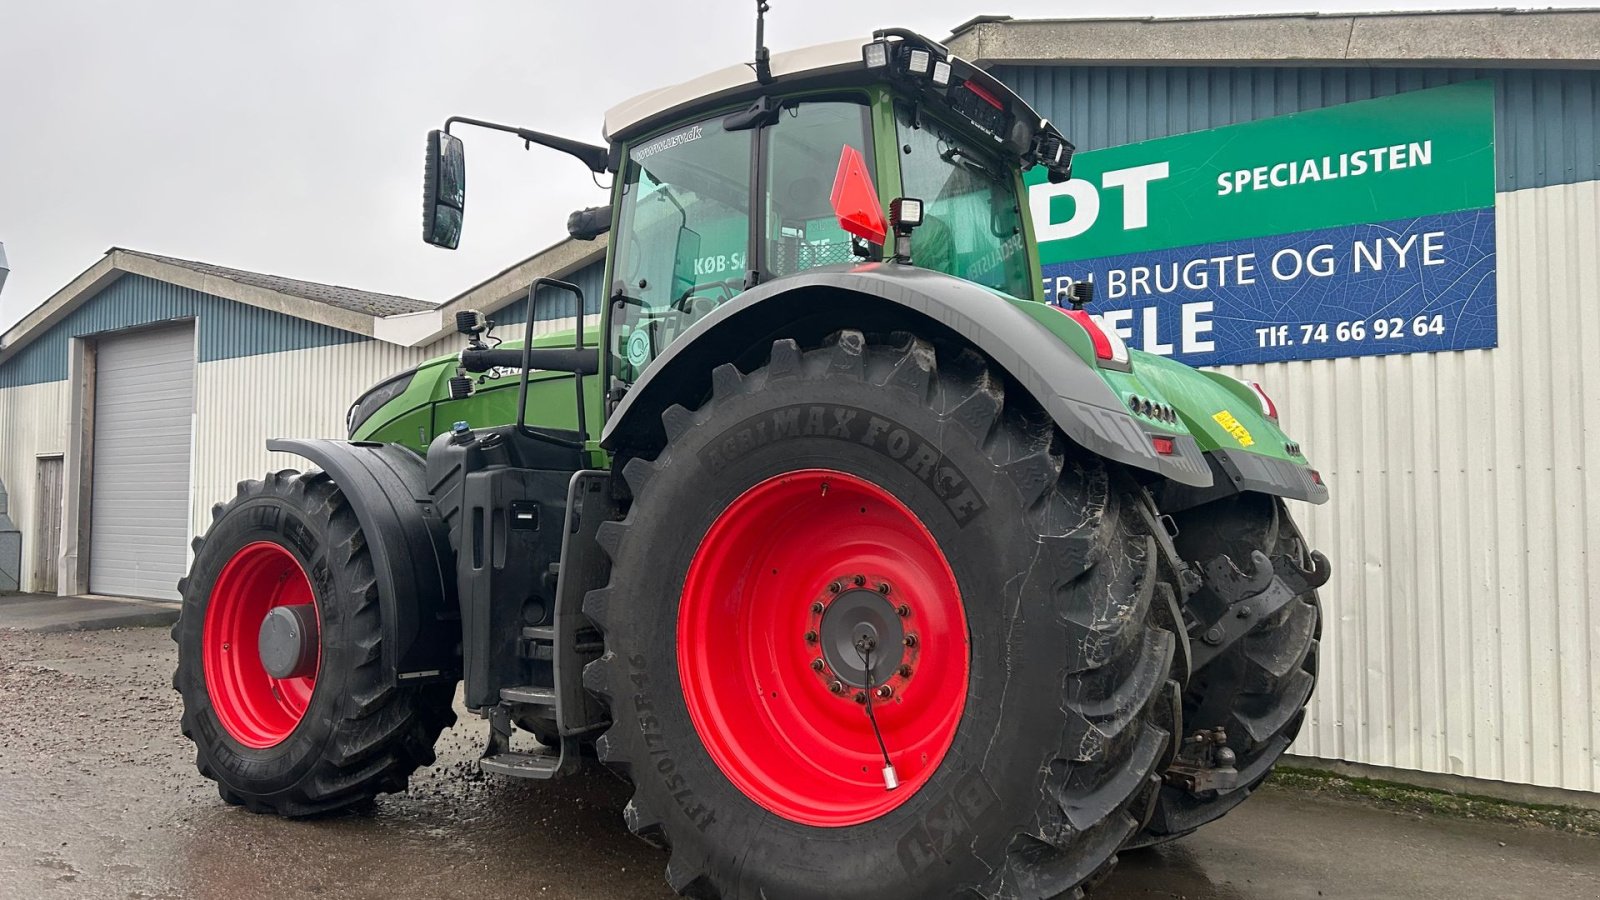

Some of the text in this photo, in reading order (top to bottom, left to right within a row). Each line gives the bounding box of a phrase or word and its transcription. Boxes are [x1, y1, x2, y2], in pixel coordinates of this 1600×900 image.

[1217, 140, 1433, 196] SPECIALISTEN
[1107, 252, 1256, 299] BRUGTE
[1271, 244, 1335, 281] OG
[1354, 231, 1445, 273] NYE
[1255, 314, 1446, 348] Tlf. 74 66 92 64
[708, 405, 985, 522] AGRIMAX FORCE
